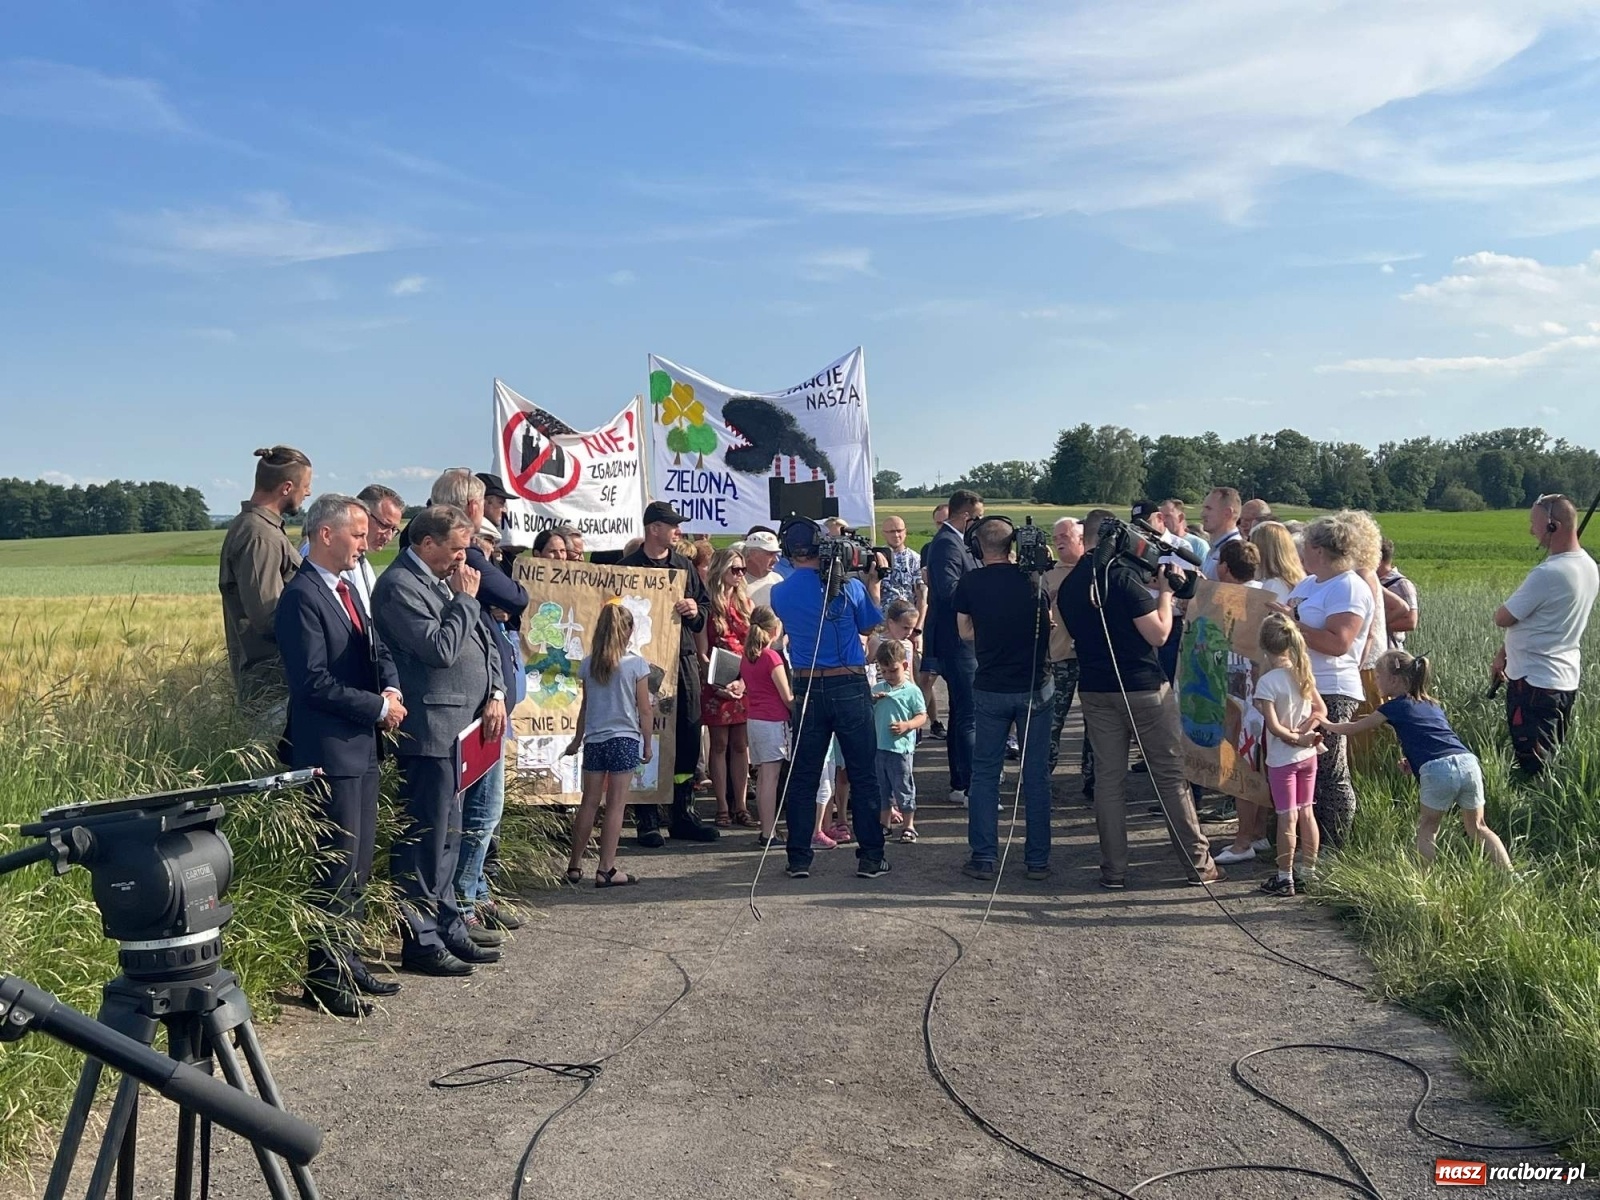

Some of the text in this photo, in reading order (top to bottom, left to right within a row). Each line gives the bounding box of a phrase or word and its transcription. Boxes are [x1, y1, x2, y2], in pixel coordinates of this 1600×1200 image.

[806, 384, 861, 410] NASZĄ
[580, 411, 635, 459] NIE!
[587, 460, 638, 479] ZGADZAMY
[600, 485, 617, 507] SIĘ
[664, 469, 739, 500] ZIELONĄ
[501, 511, 520, 530] NA
[523, 513, 572, 533] BUDOW
[518, 564, 678, 596] NIE ZATRUWAJCIE NAS!
[532, 716, 554, 731] NIE
